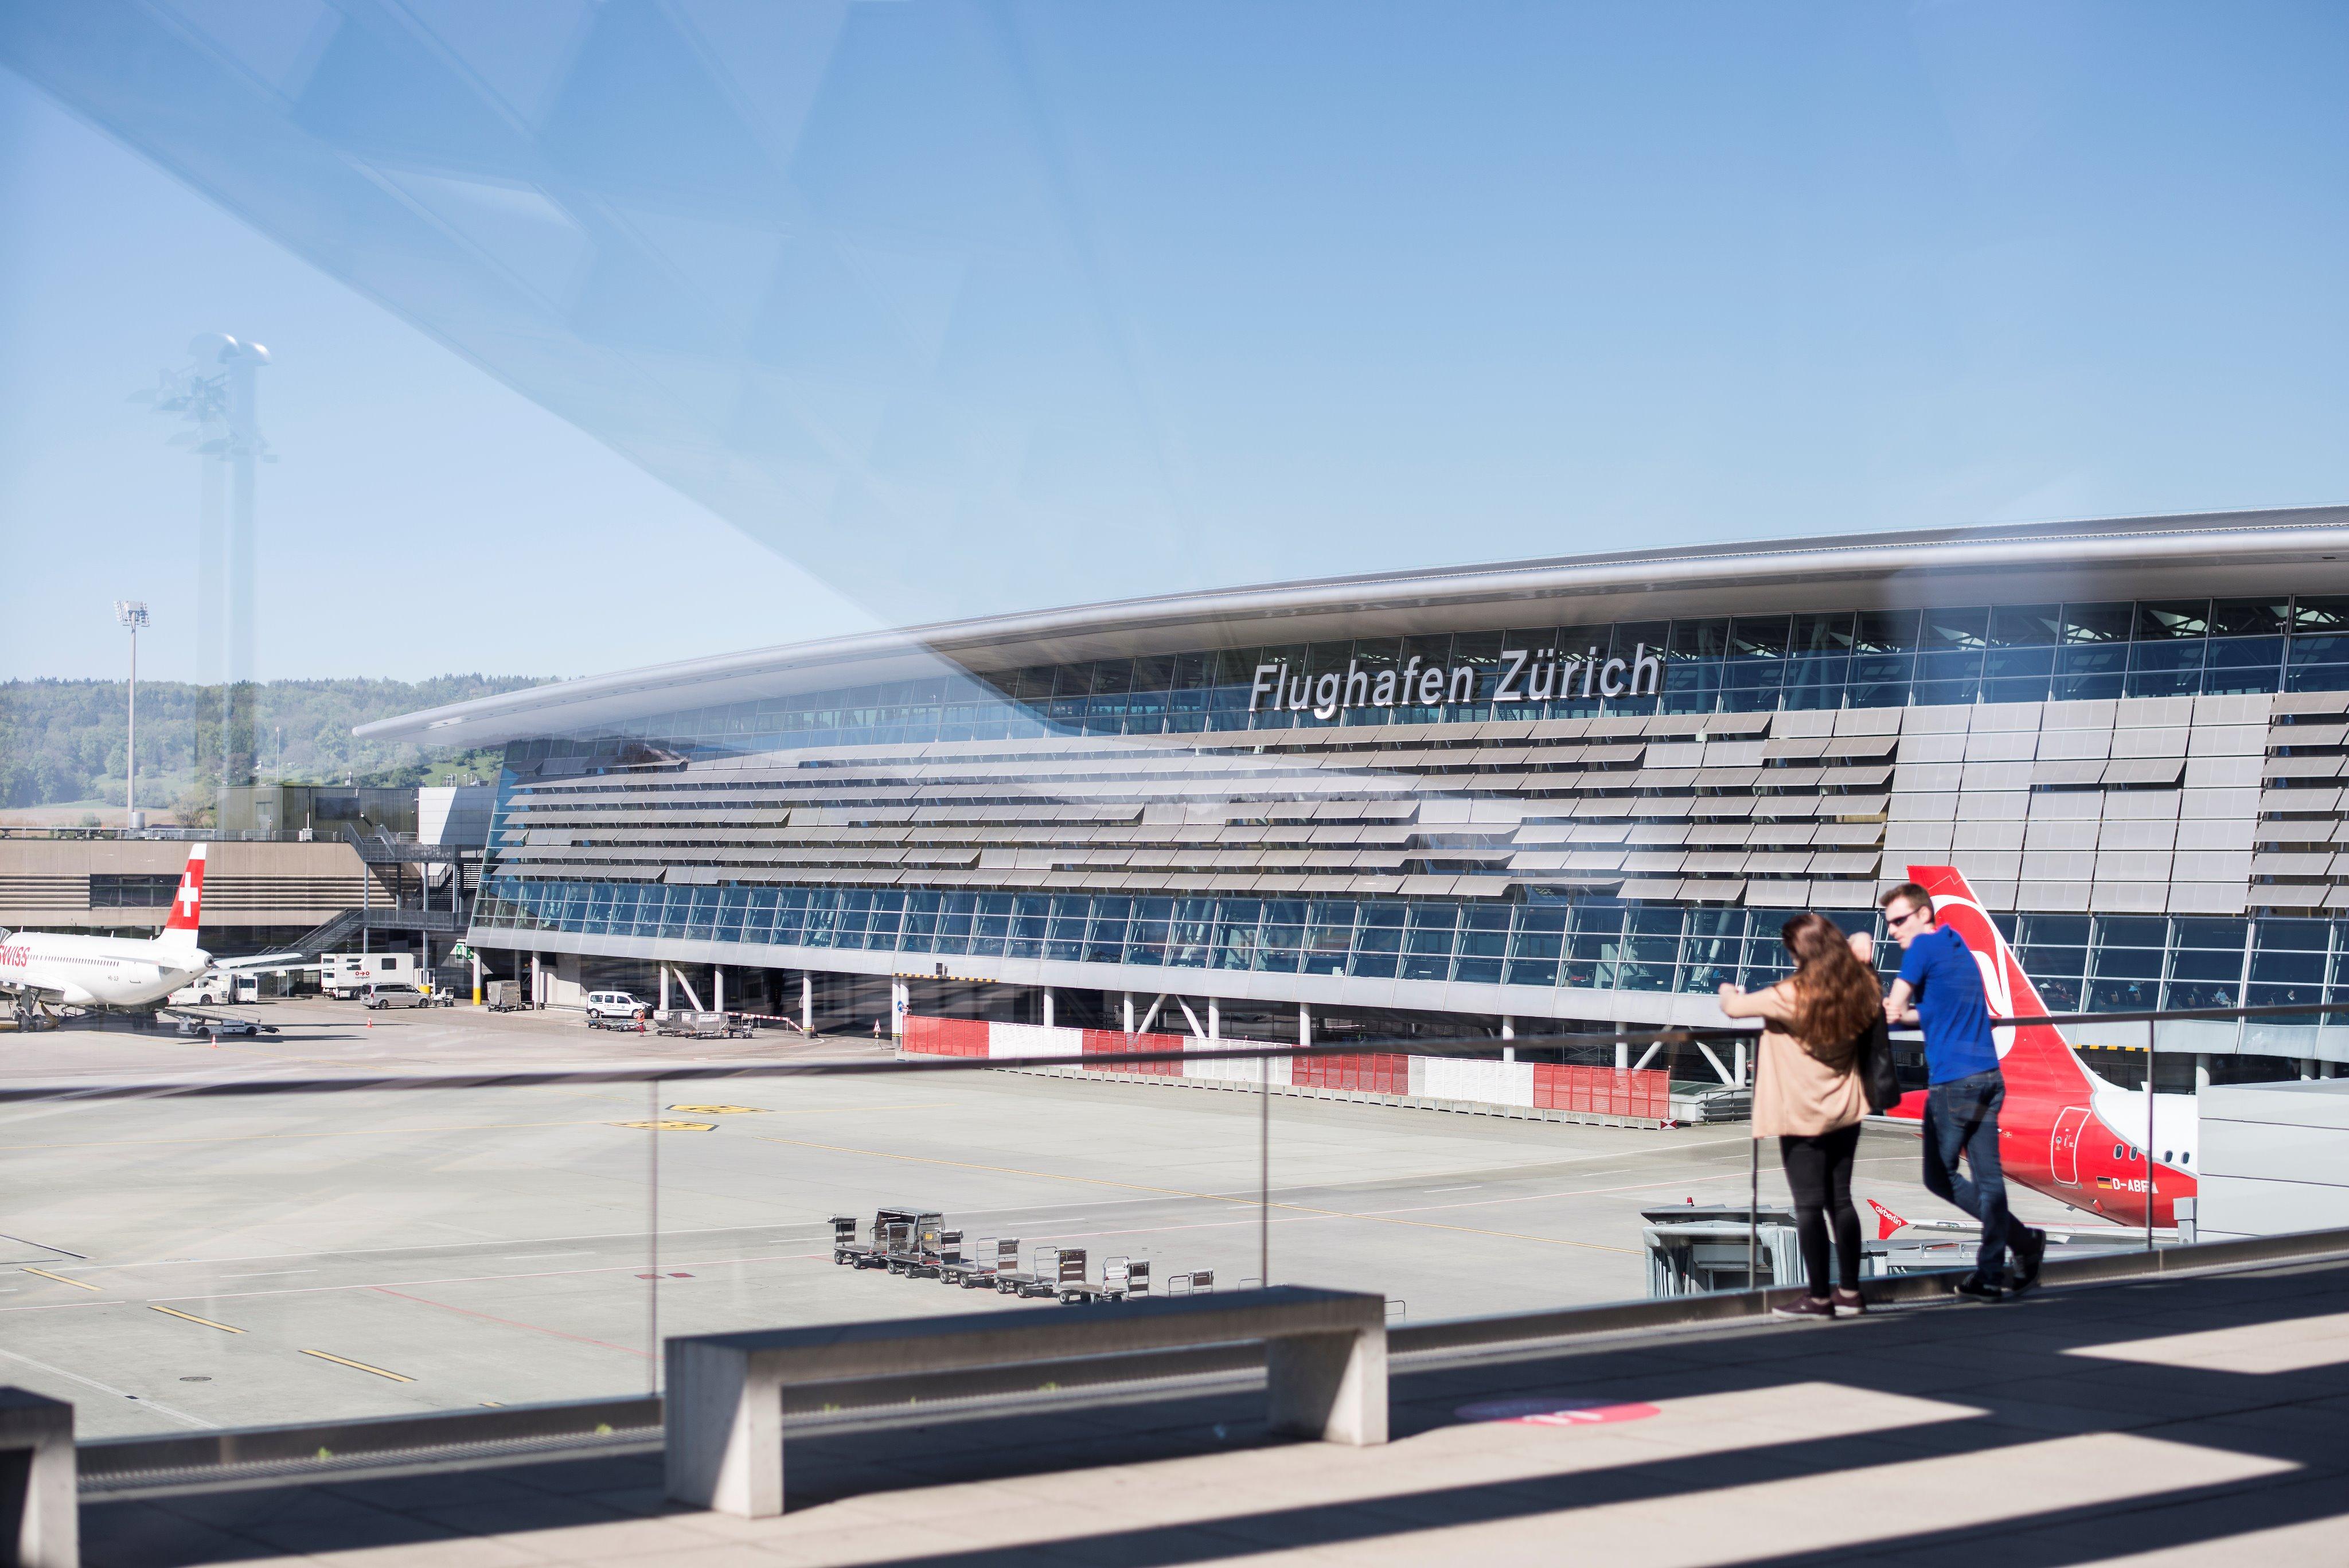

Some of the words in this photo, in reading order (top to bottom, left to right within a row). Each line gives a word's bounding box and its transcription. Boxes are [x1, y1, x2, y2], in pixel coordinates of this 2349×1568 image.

[1248, 656, 1476, 720] Flughafen
[1492, 642, 1662, 701] Zürich
[1875, 1206, 1902, 1227] airberlin
